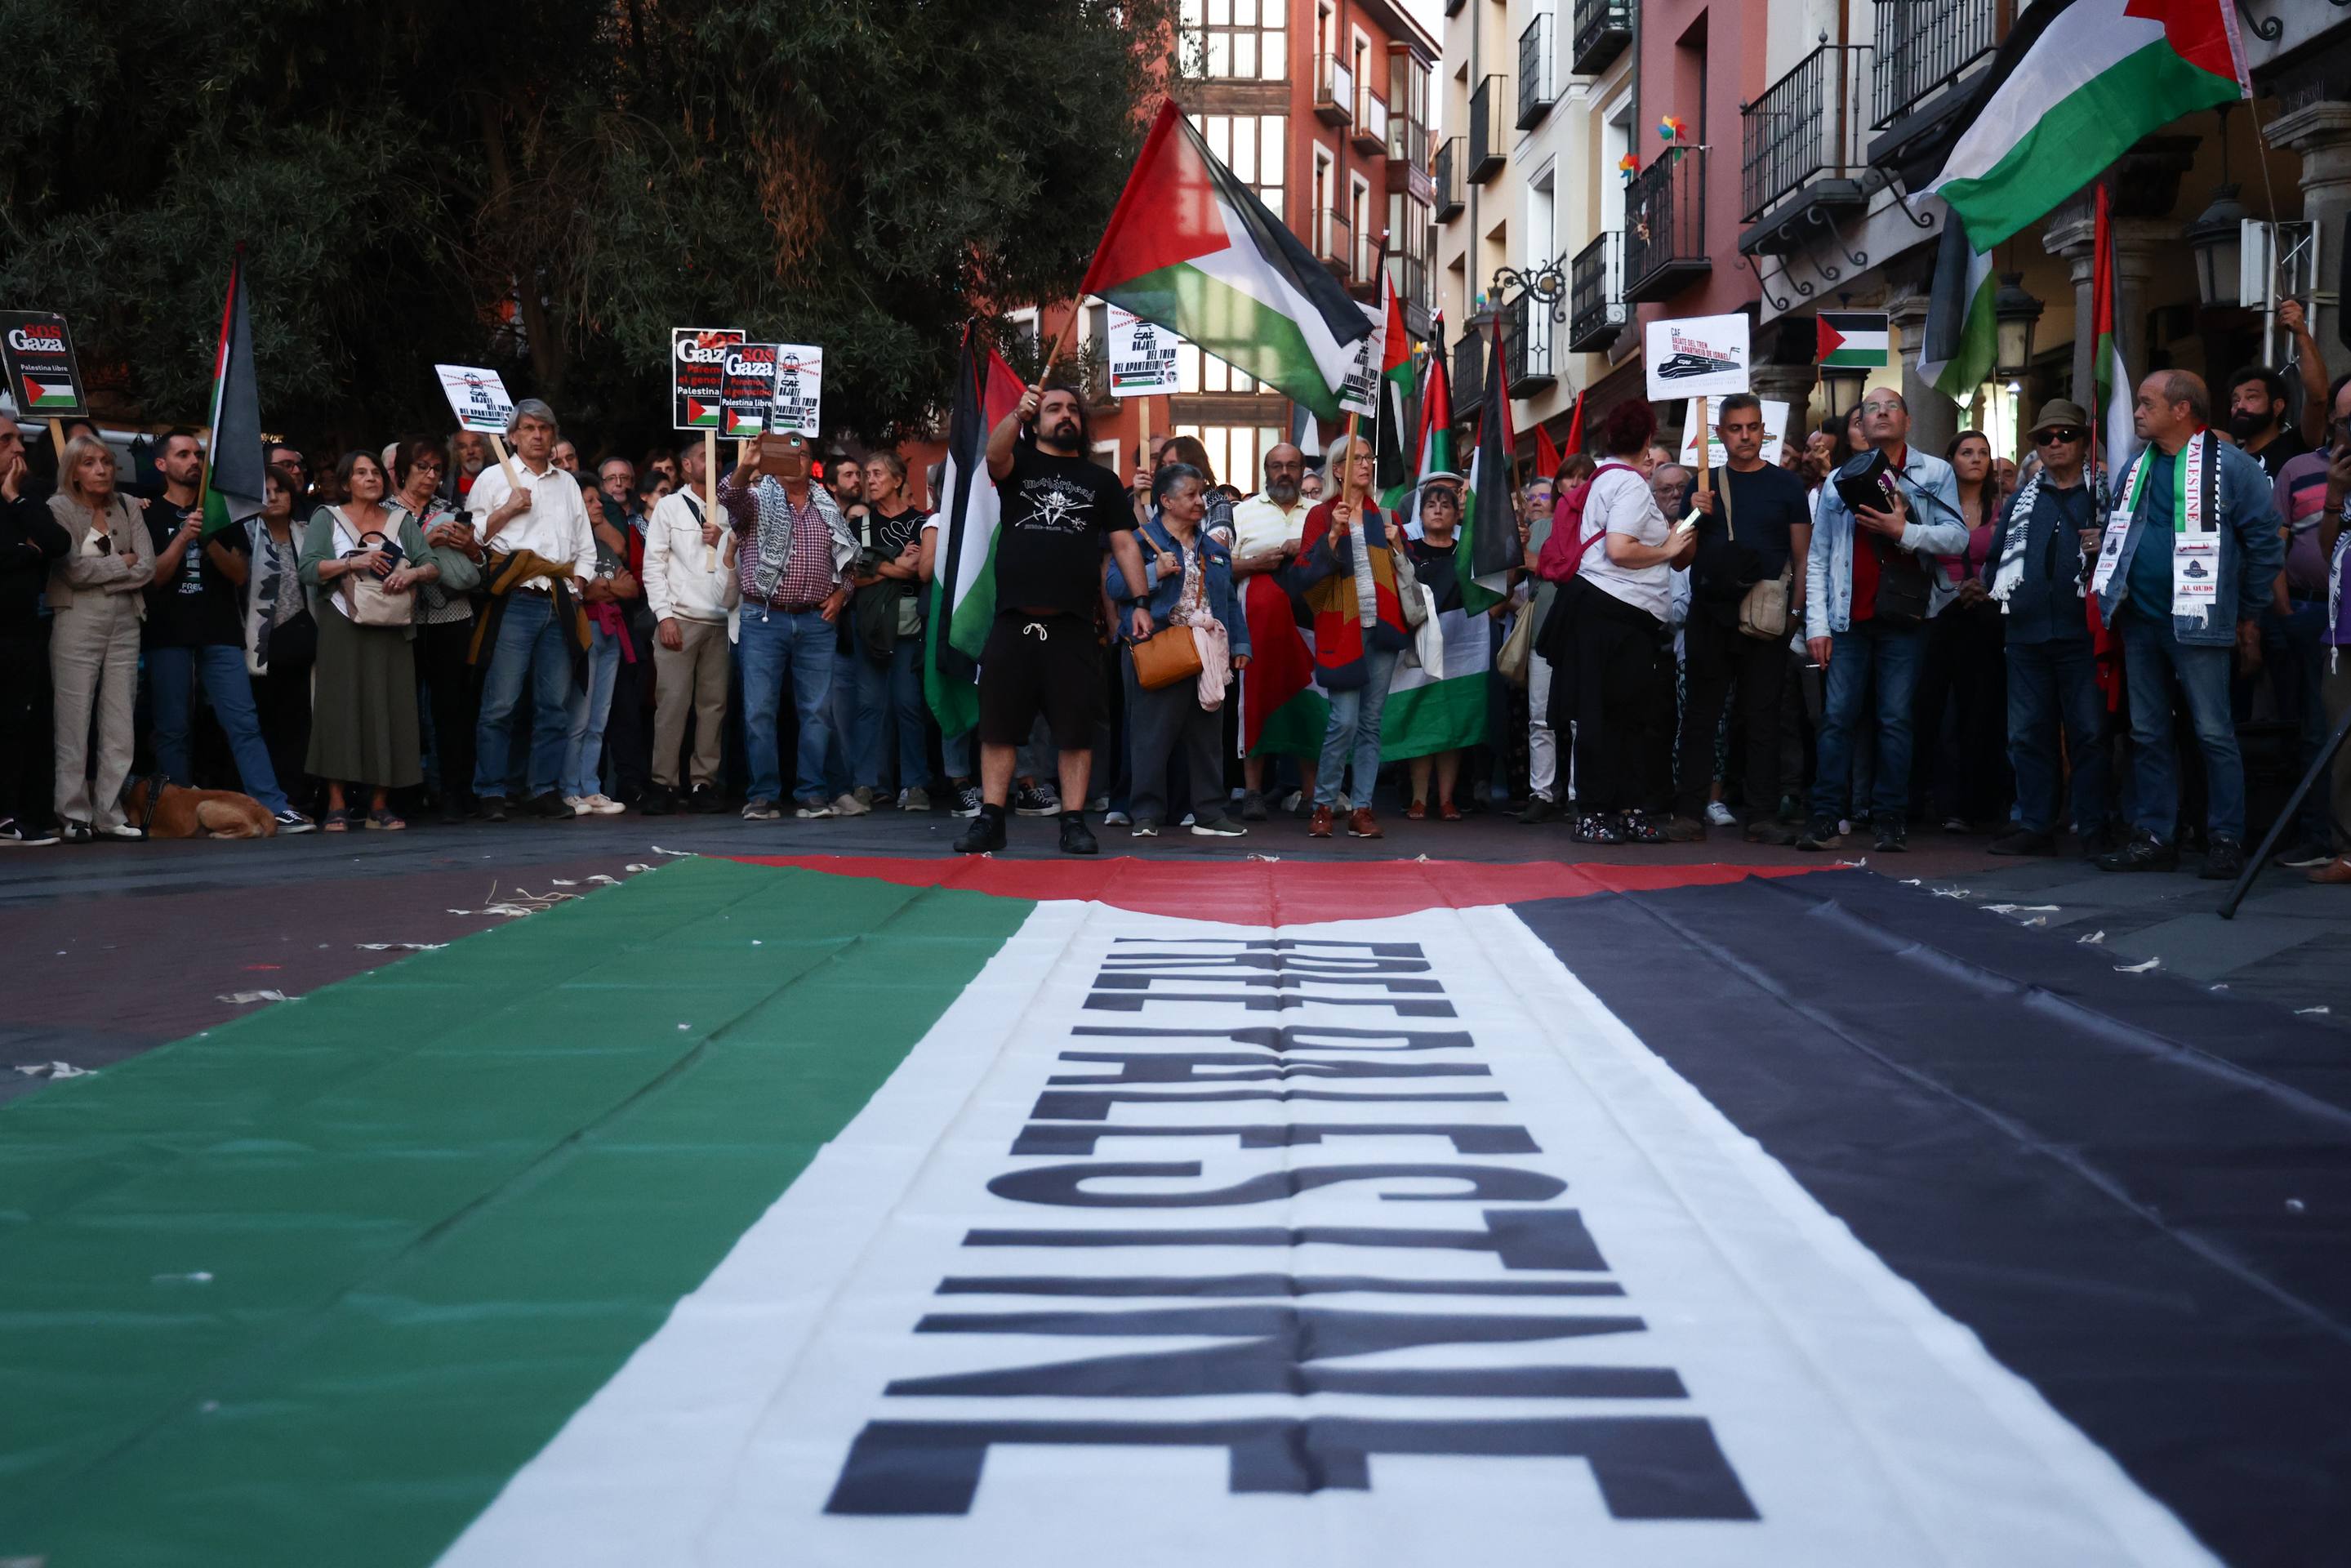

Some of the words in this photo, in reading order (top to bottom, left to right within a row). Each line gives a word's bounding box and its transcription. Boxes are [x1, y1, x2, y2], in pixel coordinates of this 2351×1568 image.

[1133, 332, 1155, 340] CAF
[1671, 327, 1681, 337] CAF
[8, 329, 66, 352] Gaza
[1687, 339, 1696, 348] DEL
[1696, 341, 1708, 350] TREN
[677, 339, 725, 363] Gaz
[1147, 350, 1157, 360] DEL
[1159, 349, 1176, 359] TREN
[1672, 344, 1681, 352] DEL
[1681, 345, 1706, 357] APARTHEID
[1706, 350, 1712, 358] DE
[1712, 351, 1730, 361] ISRAEL
[20, 363, 51, 372] Palestina
[52, 364, 69, 372] libre
[687, 364, 723, 373] Parem
[725, 354, 775, 376] Gaza
[1113, 363, 1124, 372] DEL
[679, 376, 688, 384] el
[690, 376, 722, 386] genoc
[731, 377, 766, 386] Paremos
[781, 379, 799, 388] CAF
[677, 386, 719, 395] Palestina
[722, 399, 754, 407] Palestina
[755, 399, 773, 408] libre
[790, 397, 800, 406] DEL
[802, 397, 817, 408] TREN
[776, 405, 805, 415] PARTHEID!!
[1877, 479, 1890, 495] CGT
[2187, 442, 2202, 522] PALESTINE
[2193, 584, 2214, 592] QUDS
[1081, 937, 1458, 1018] FREE
[822, 1024, 1763, 1521] PALESTINE
